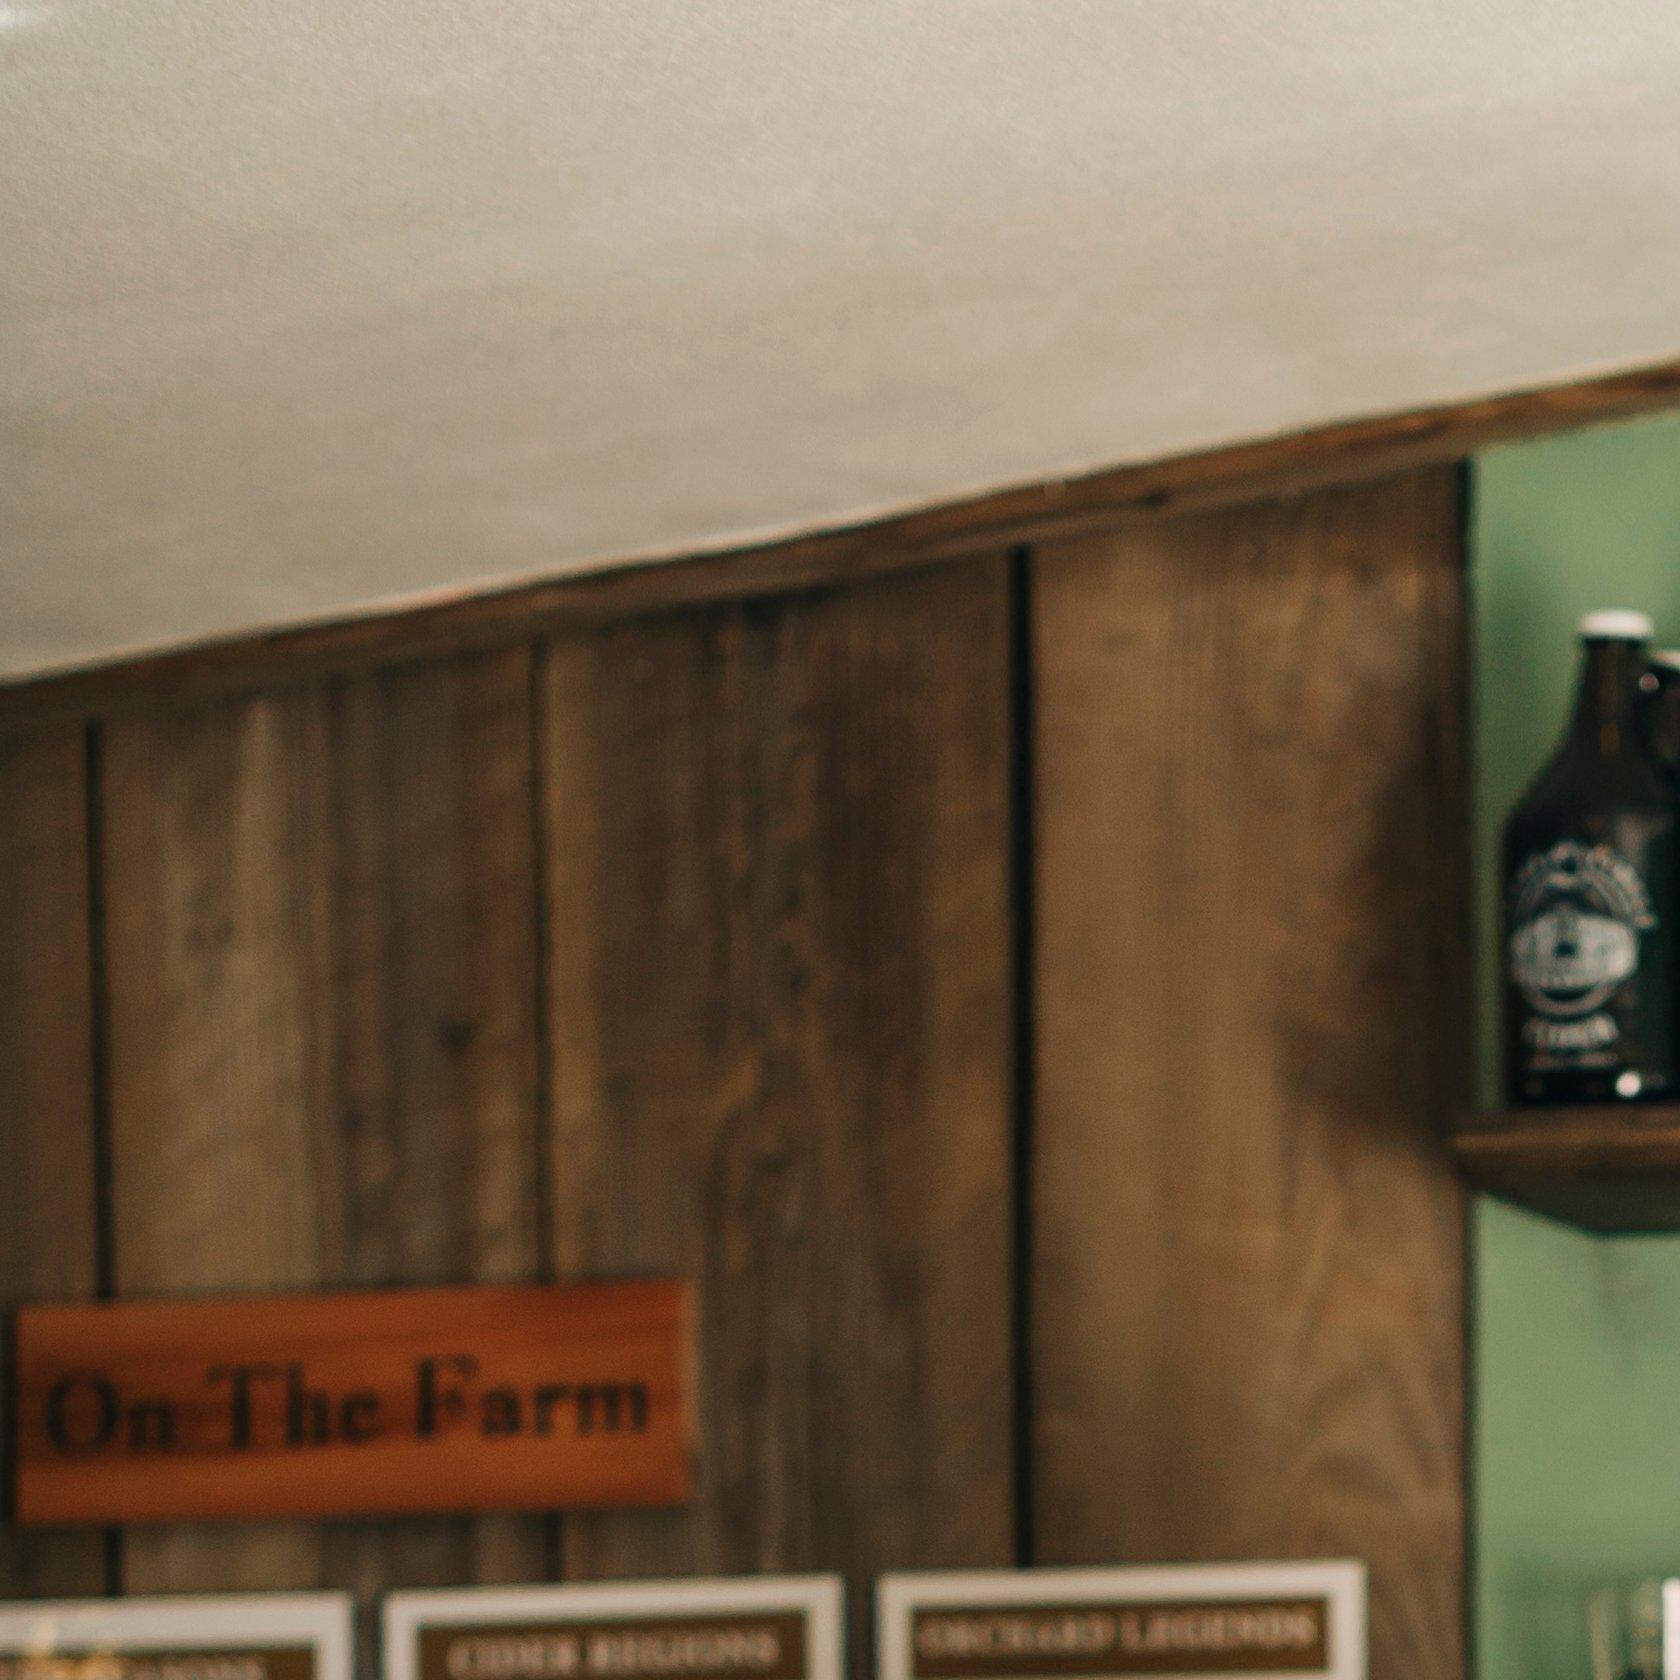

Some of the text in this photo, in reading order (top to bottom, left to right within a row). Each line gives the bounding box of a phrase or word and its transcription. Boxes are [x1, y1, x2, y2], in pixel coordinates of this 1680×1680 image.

[44, 1353, 650, 1457] On The Farm
[589, 1626, 779, 1675] REGIONS
[918, 1606, 1318, 1658] ORCHARD LEGENDS
